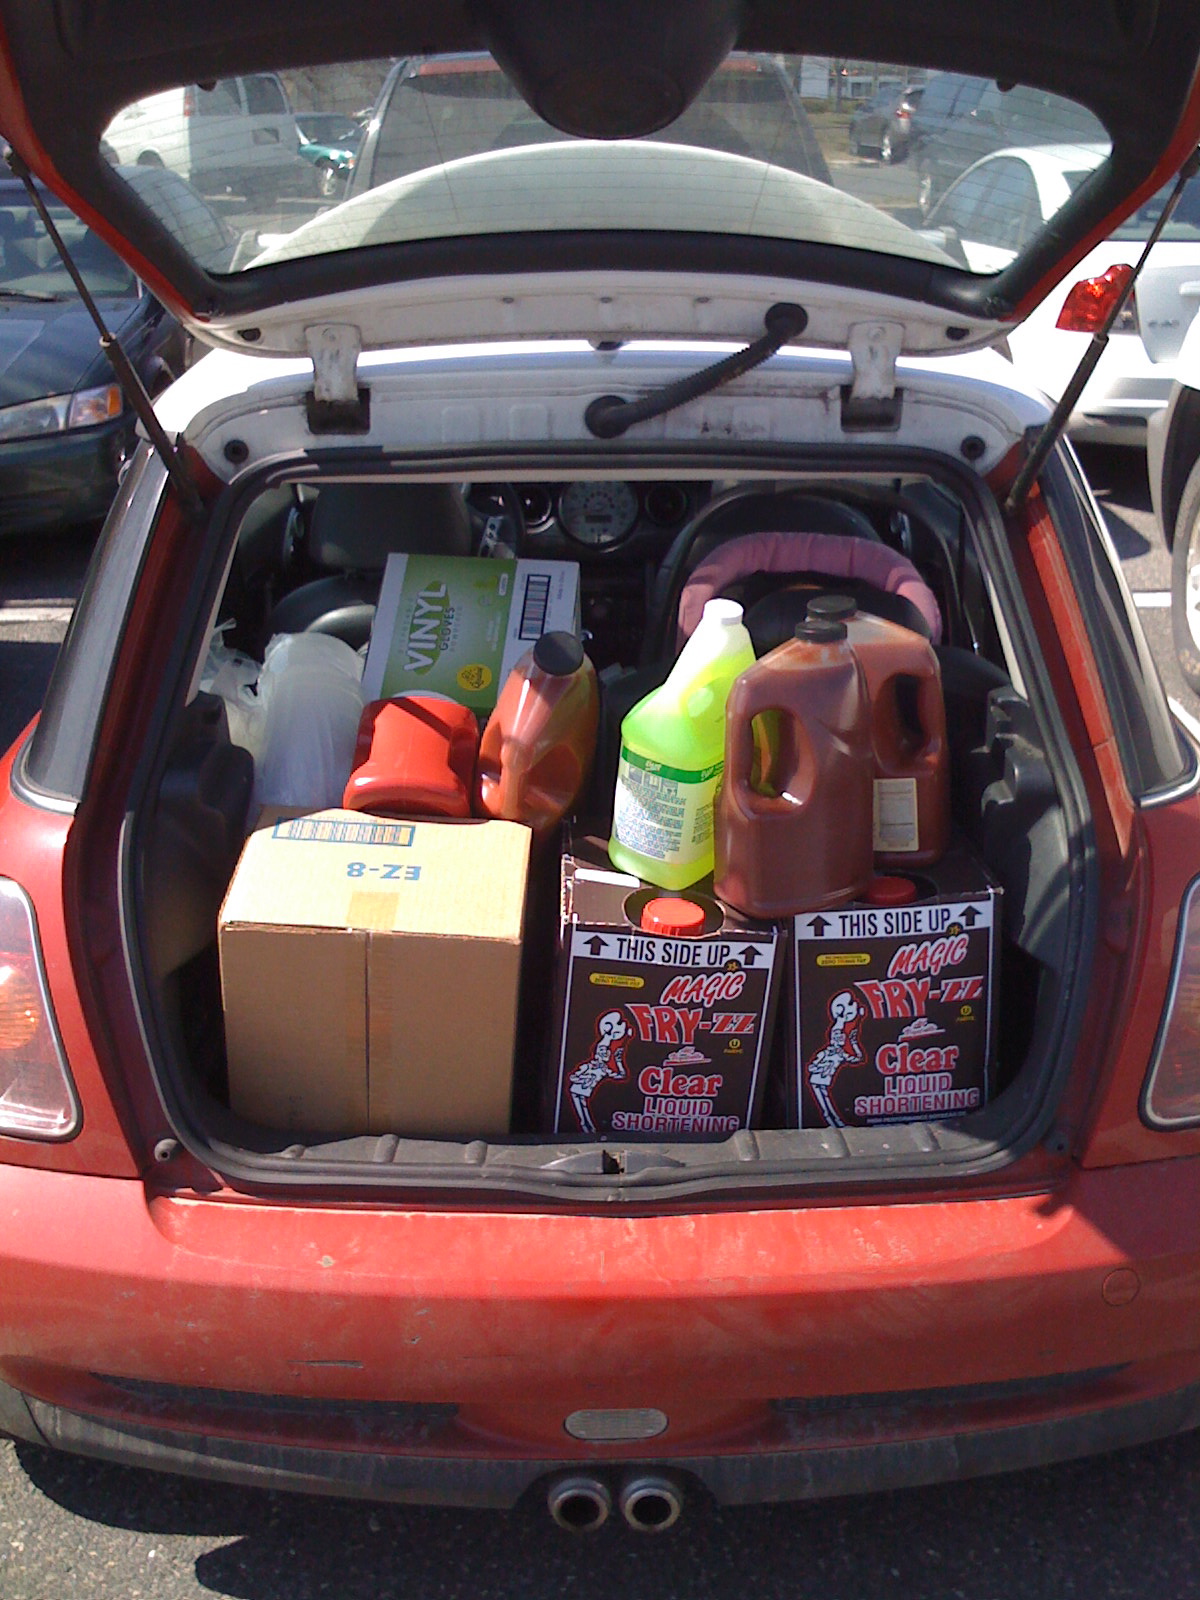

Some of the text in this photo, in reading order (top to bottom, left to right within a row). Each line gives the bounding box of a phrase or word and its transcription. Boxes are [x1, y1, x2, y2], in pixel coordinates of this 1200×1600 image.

[404, 583, 447, 671] VINYL
[439, 607, 455, 651] GLOVES
[346, 862, 421, 881] EZ-8
[838, 913, 877, 937] THIS
[889, 910, 922, 935] SIDE
[929, 908, 951, 932] UP
[616, 938, 730, 966] THIS SIDE UP
[887, 933, 969, 978] MAGIC
[660, 971, 746, 1007] MAGIC
[853, 975, 984, 1018] FRY-ZZ
[624, 1003, 757, 1044] FRY-ZZ
[876, 1042, 959, 1075] Clear
[638, 1066, 723, 1097] Clear
[884, 1072, 952, 1096] LIQUID
[645, 1096, 713, 1116] LIQUID
[854, 1087, 980, 1116] SHORTENING
[612, 1112, 740, 1132] SHORTENING
